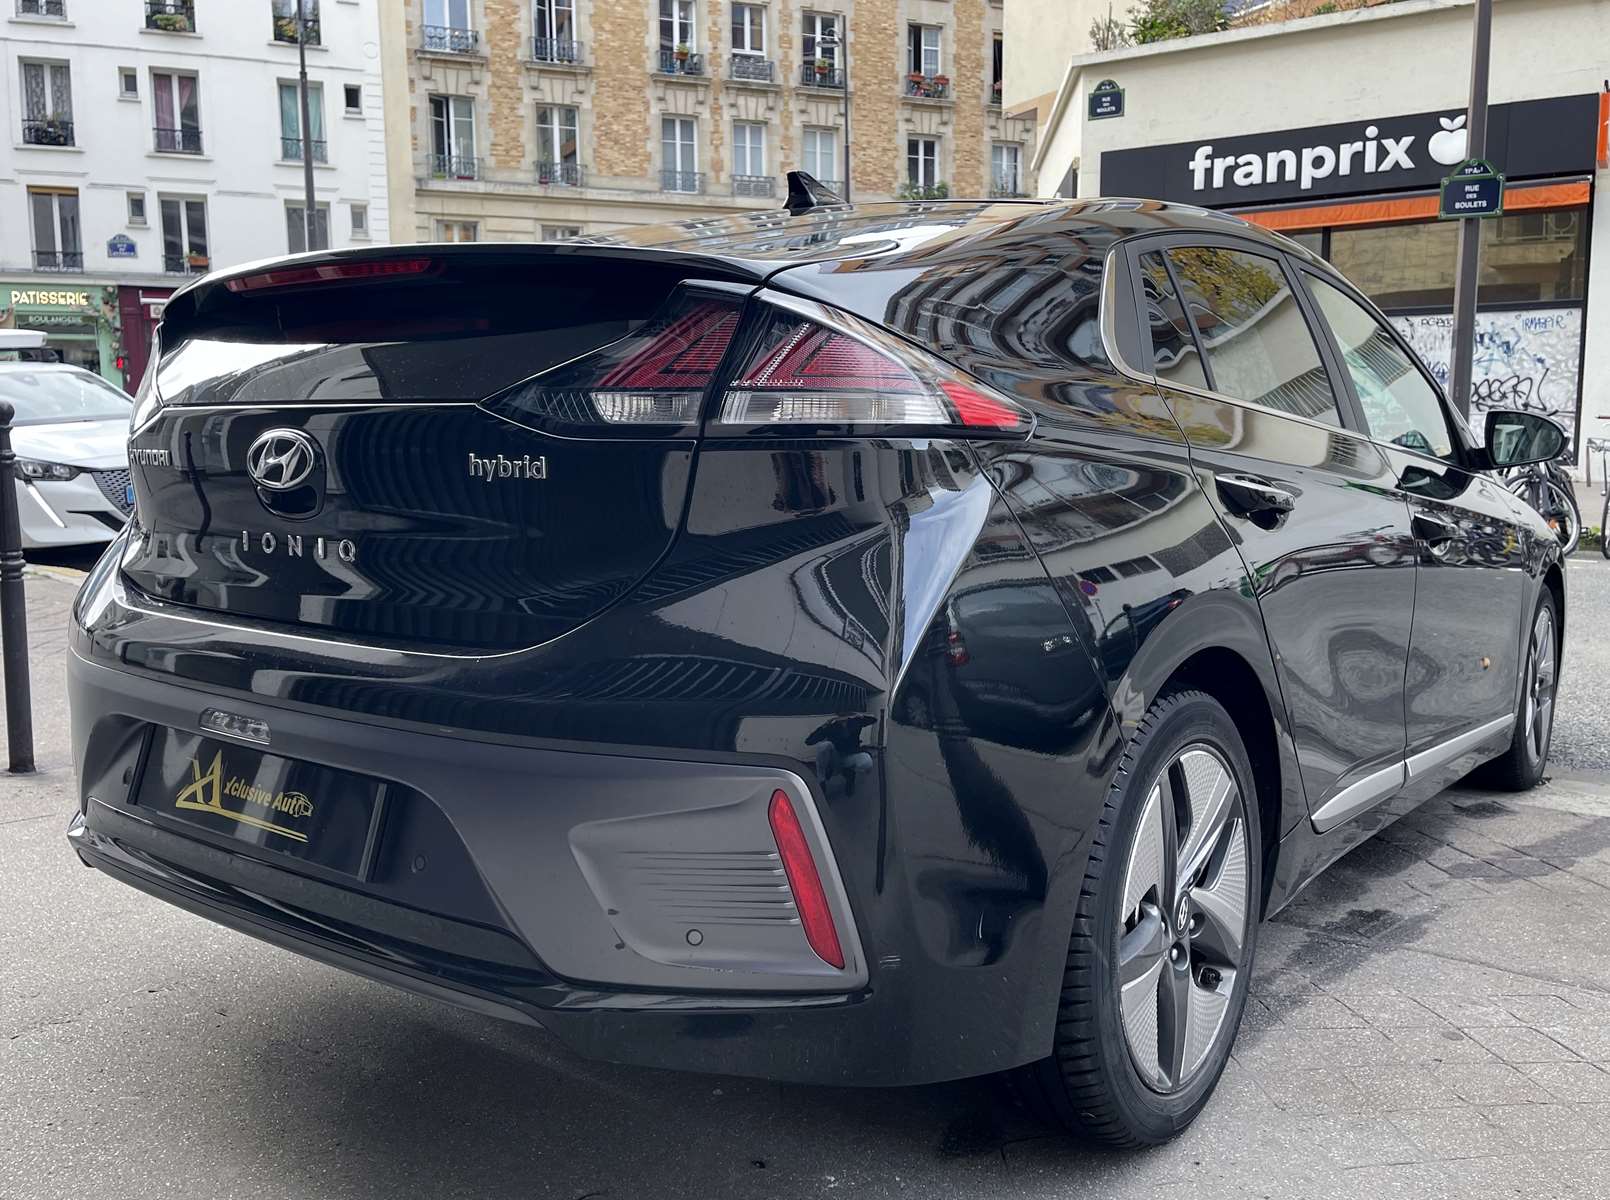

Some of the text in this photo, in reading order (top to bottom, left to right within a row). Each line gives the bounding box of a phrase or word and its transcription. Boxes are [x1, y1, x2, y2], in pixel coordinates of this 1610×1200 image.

[1189, 126, 1415, 190] franprix
[1464, 184, 1480, 192] RUE
[1454, 200, 1487, 209] BOULETS
[11, 290, 88, 305] PATISSERIE
[129, 448, 170, 467] HYUNDAI
[468, 453, 546, 482] hybrid
[241, 530, 357, 563] IONIQ
